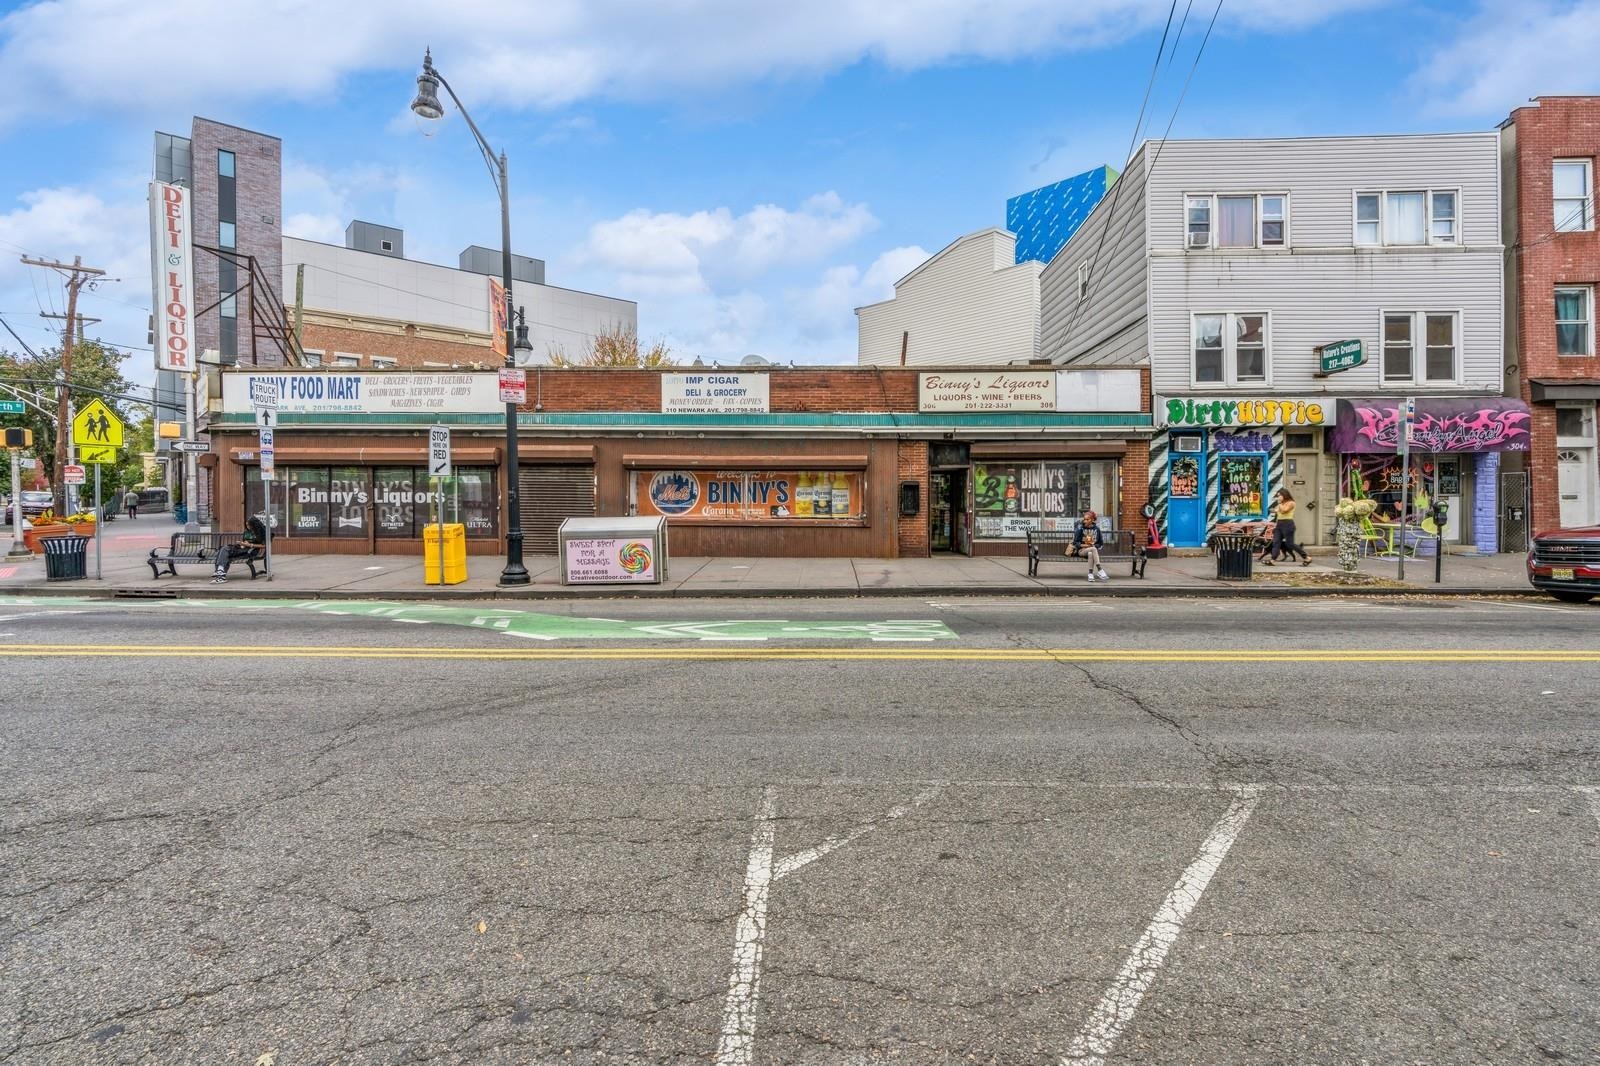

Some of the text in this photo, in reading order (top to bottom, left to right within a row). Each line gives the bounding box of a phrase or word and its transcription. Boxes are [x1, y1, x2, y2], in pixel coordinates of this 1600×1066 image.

[163, 186, 188, 366] DELI & LIQUOR
[1340, 343, 1360, 354] Creations
[365, 376, 379, 385] DELI
[383, 376, 410, 385] GROCERY
[437, 376, 473, 384] VEGETABLES
[925, 376, 1050, 392] Binny's Liquors
[255, 385, 276, 394] TRUCK
[291, 376, 323, 399] FOOD
[328, 376, 361, 399] MART
[368, 388, 406, 397] SANDWICHES
[255, 395, 276, 404] ROUTE
[390, 399, 444, 408] MAGAZINES CIGAR
[432, 431, 448, 442] STOP
[1454, 422, 1502, 450] Angel
[434, 449, 447, 459] RED
[1021, 469, 1065, 489] BINNY'S
[298, 488, 445, 507] Binny's Liquors
[708, 480, 789, 504] BINNY'S
[1021, 492, 1065, 512] LIQUORS
[702, 506, 734, 516] Corona
